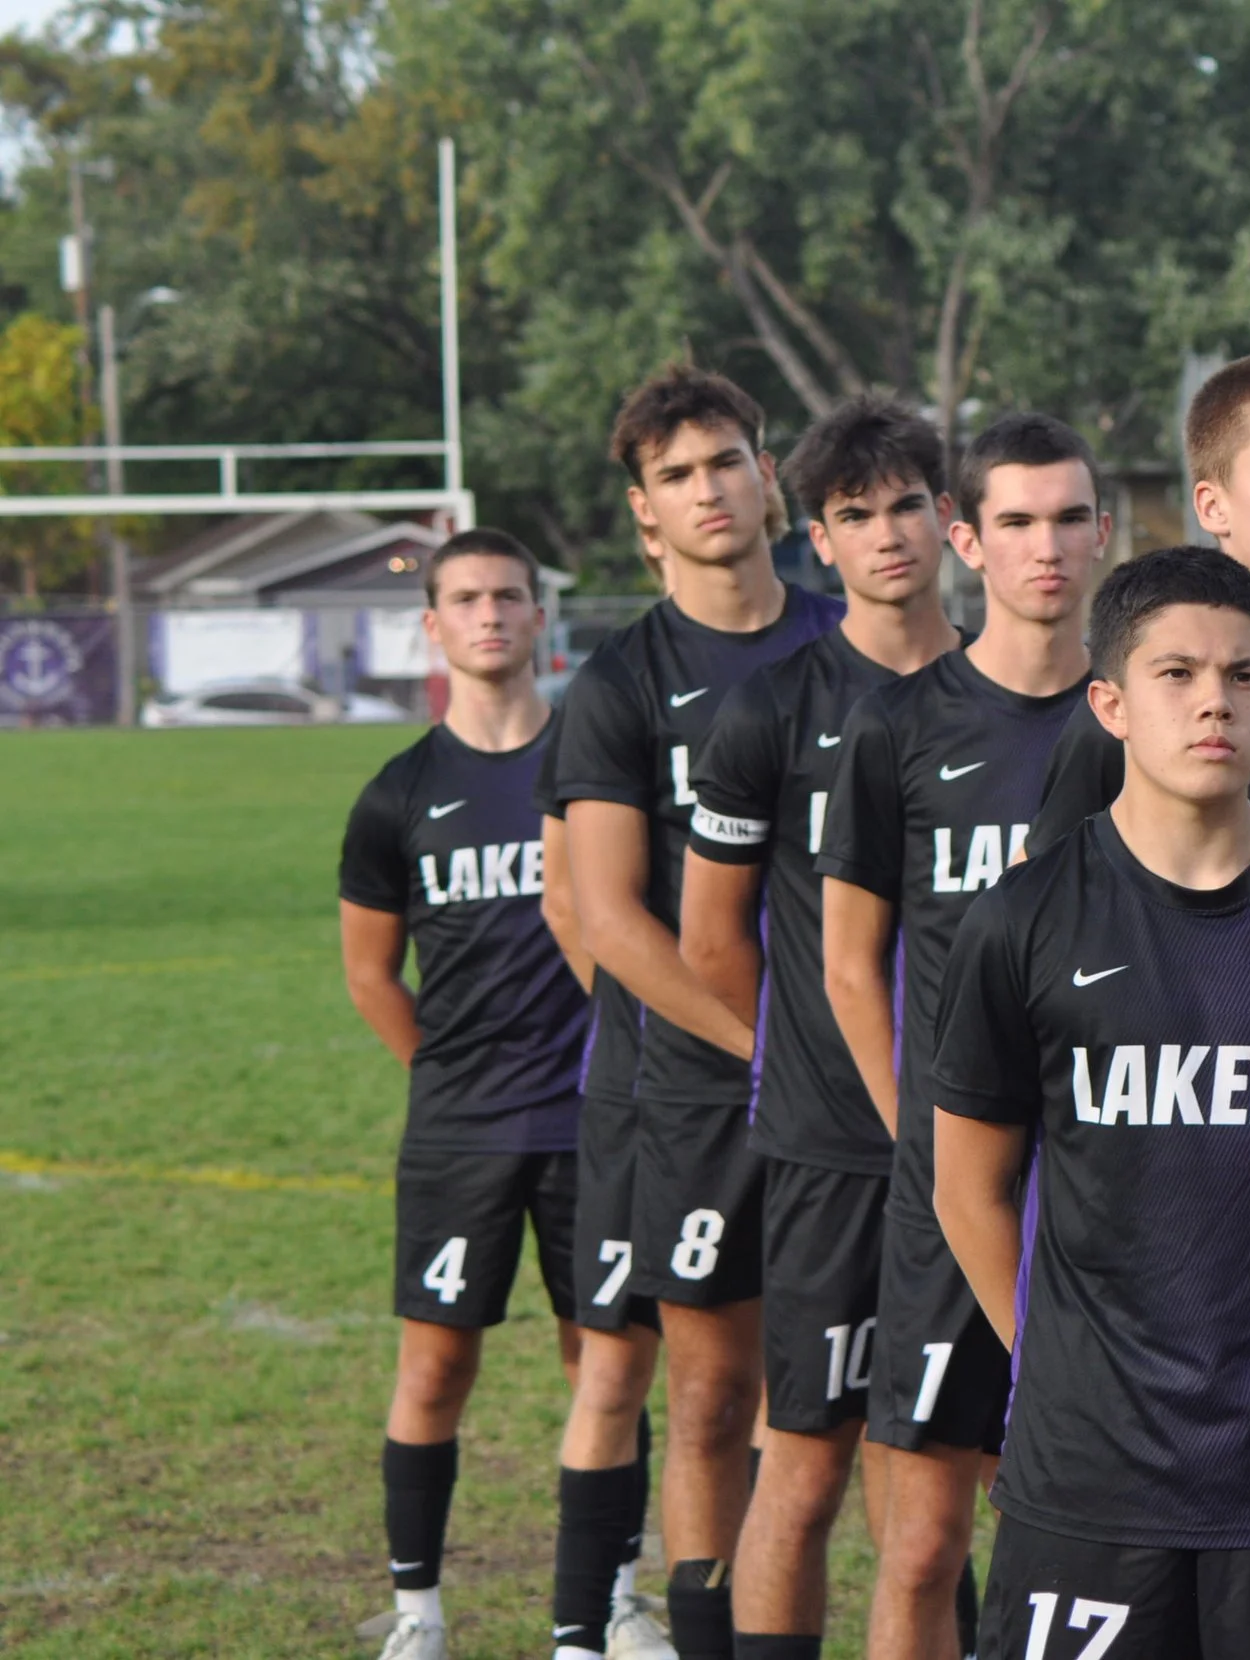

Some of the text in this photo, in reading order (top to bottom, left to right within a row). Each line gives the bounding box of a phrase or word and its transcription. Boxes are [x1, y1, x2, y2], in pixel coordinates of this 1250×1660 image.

[423, 1236, 468, 1304] 4
[591, 1239, 632, 1305] 7
[670, 1208, 725, 1280] 8
[912, 1342, 953, 1422] 1
[1025, 1591, 1130, 1660] 17
